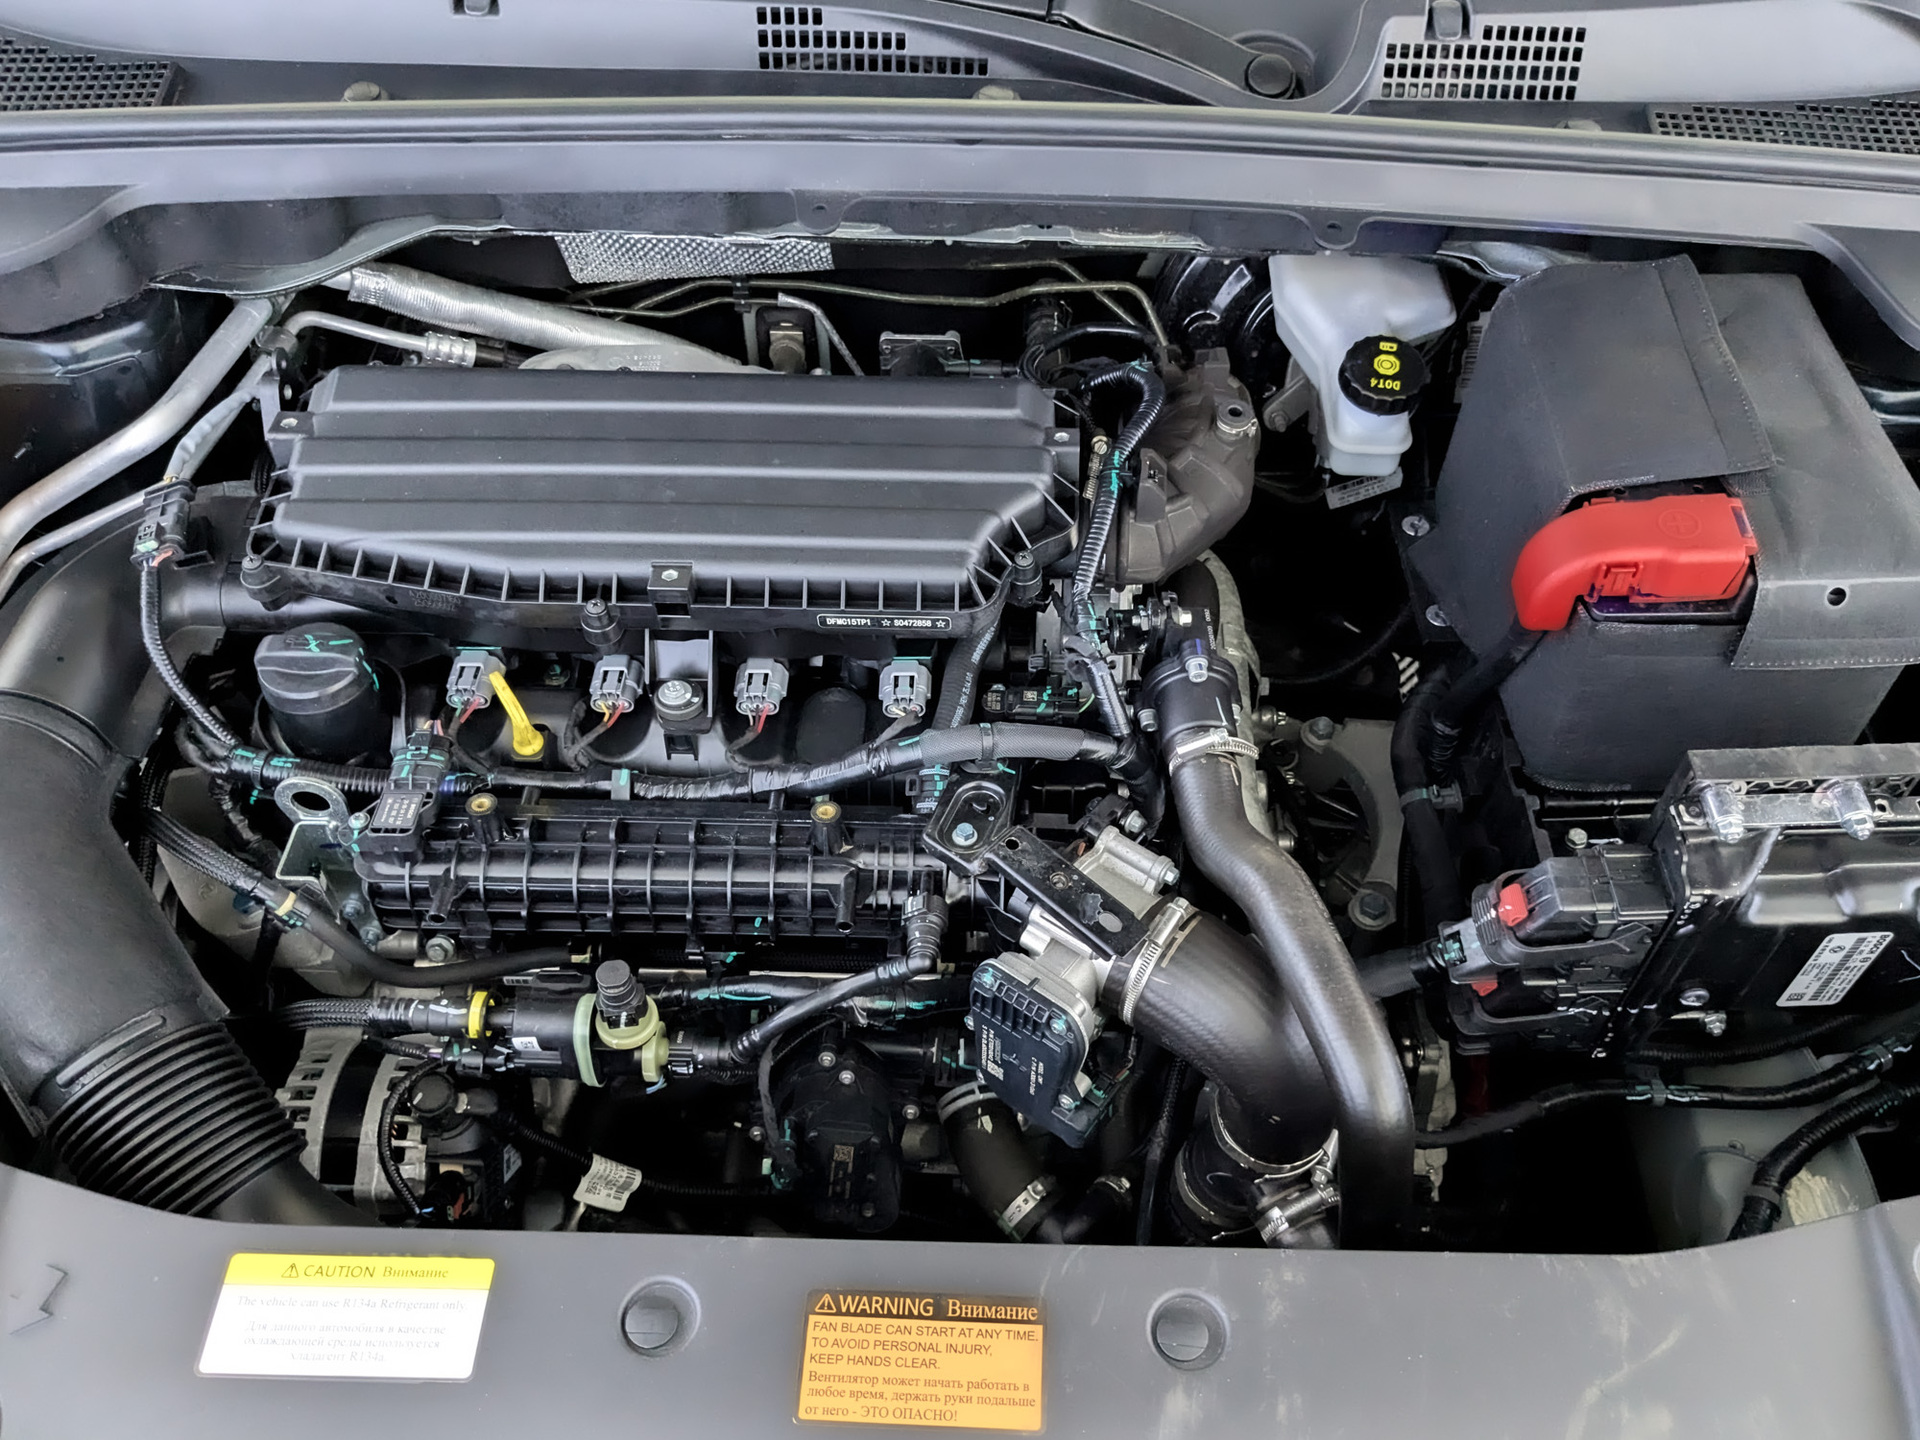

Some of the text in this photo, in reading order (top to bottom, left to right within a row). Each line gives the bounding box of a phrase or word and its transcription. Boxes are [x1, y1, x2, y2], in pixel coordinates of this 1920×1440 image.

[1370, 377, 1401, 391] DOT4
[826, 617, 871, 626] DFMC15TP1
[303, 1264, 449, 1279] CAUTION Внимание
[238, 1295, 257, 1306] The
[260, 1297, 298, 1307] vehicle
[300, 1300, 319, 1308] can
[322, 1300, 340, 1308] use
[342, 1298, 377, 1309] R134a
[380, 1298, 440, 1312] Refrigerant
[839, 1294, 1039, 1321] WARNING Внимание
[245, 1320, 267, 1333] Для
[318, 1323, 385, 1335] автомобиля
[387, 1326, 394, 1335] в
[397, 1325, 447, 1336] качестве
[813, 1321, 1039, 1342] FAN BLADE CAN START AT ANY TIME.
[812, 1337, 829, 1349] TO
[831, 1338, 870, 1350] AVOID
[873, 1339, 942, 1353] PERSONAL
[810, 1353, 941, 1370] KEEP HANDS CLEAR.
[808, 1371, 1030, 1393] Вентилятор может начать работать в
[807, 1386, 1036, 1408] любое время, держать руки подальше
[804, 1406, 820, 1415] от
[822, 1407, 849, 1417] него
[860, 1406, 890, 1418] ЭТО
[892, 1407, 958, 1422] ОПАСНО!
